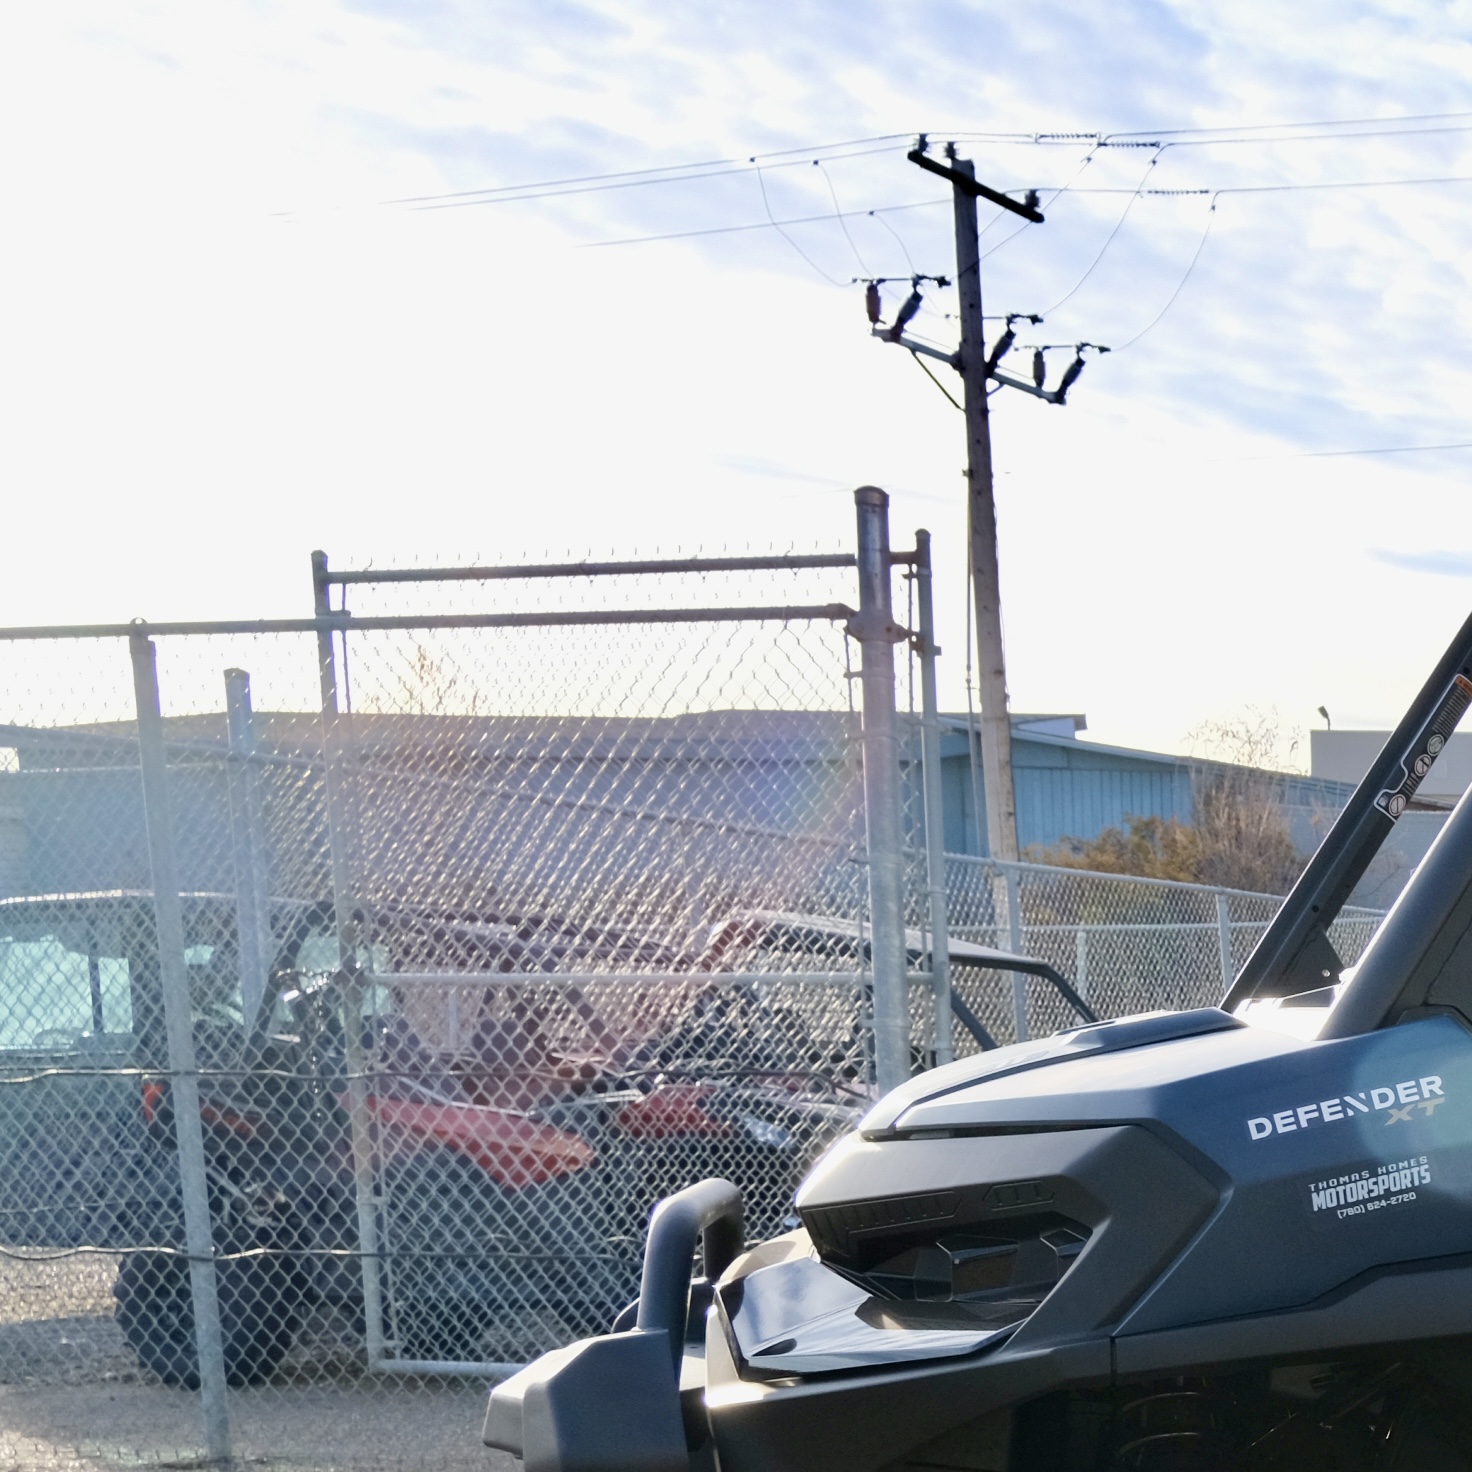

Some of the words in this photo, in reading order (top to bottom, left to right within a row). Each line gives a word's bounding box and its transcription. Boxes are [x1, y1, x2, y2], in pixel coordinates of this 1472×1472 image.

[1247, 1075, 1445, 1141] DEFENDER
[1384, 1097, 1446, 1127] XT
[1308, 1170, 1370, 1192] THOMAS
[1377, 1155, 1428, 1175] HOMES
[1311, 1164, 1431, 1212] MOTORSPORTS
[1337, 1204, 1365, 1219] (780)
